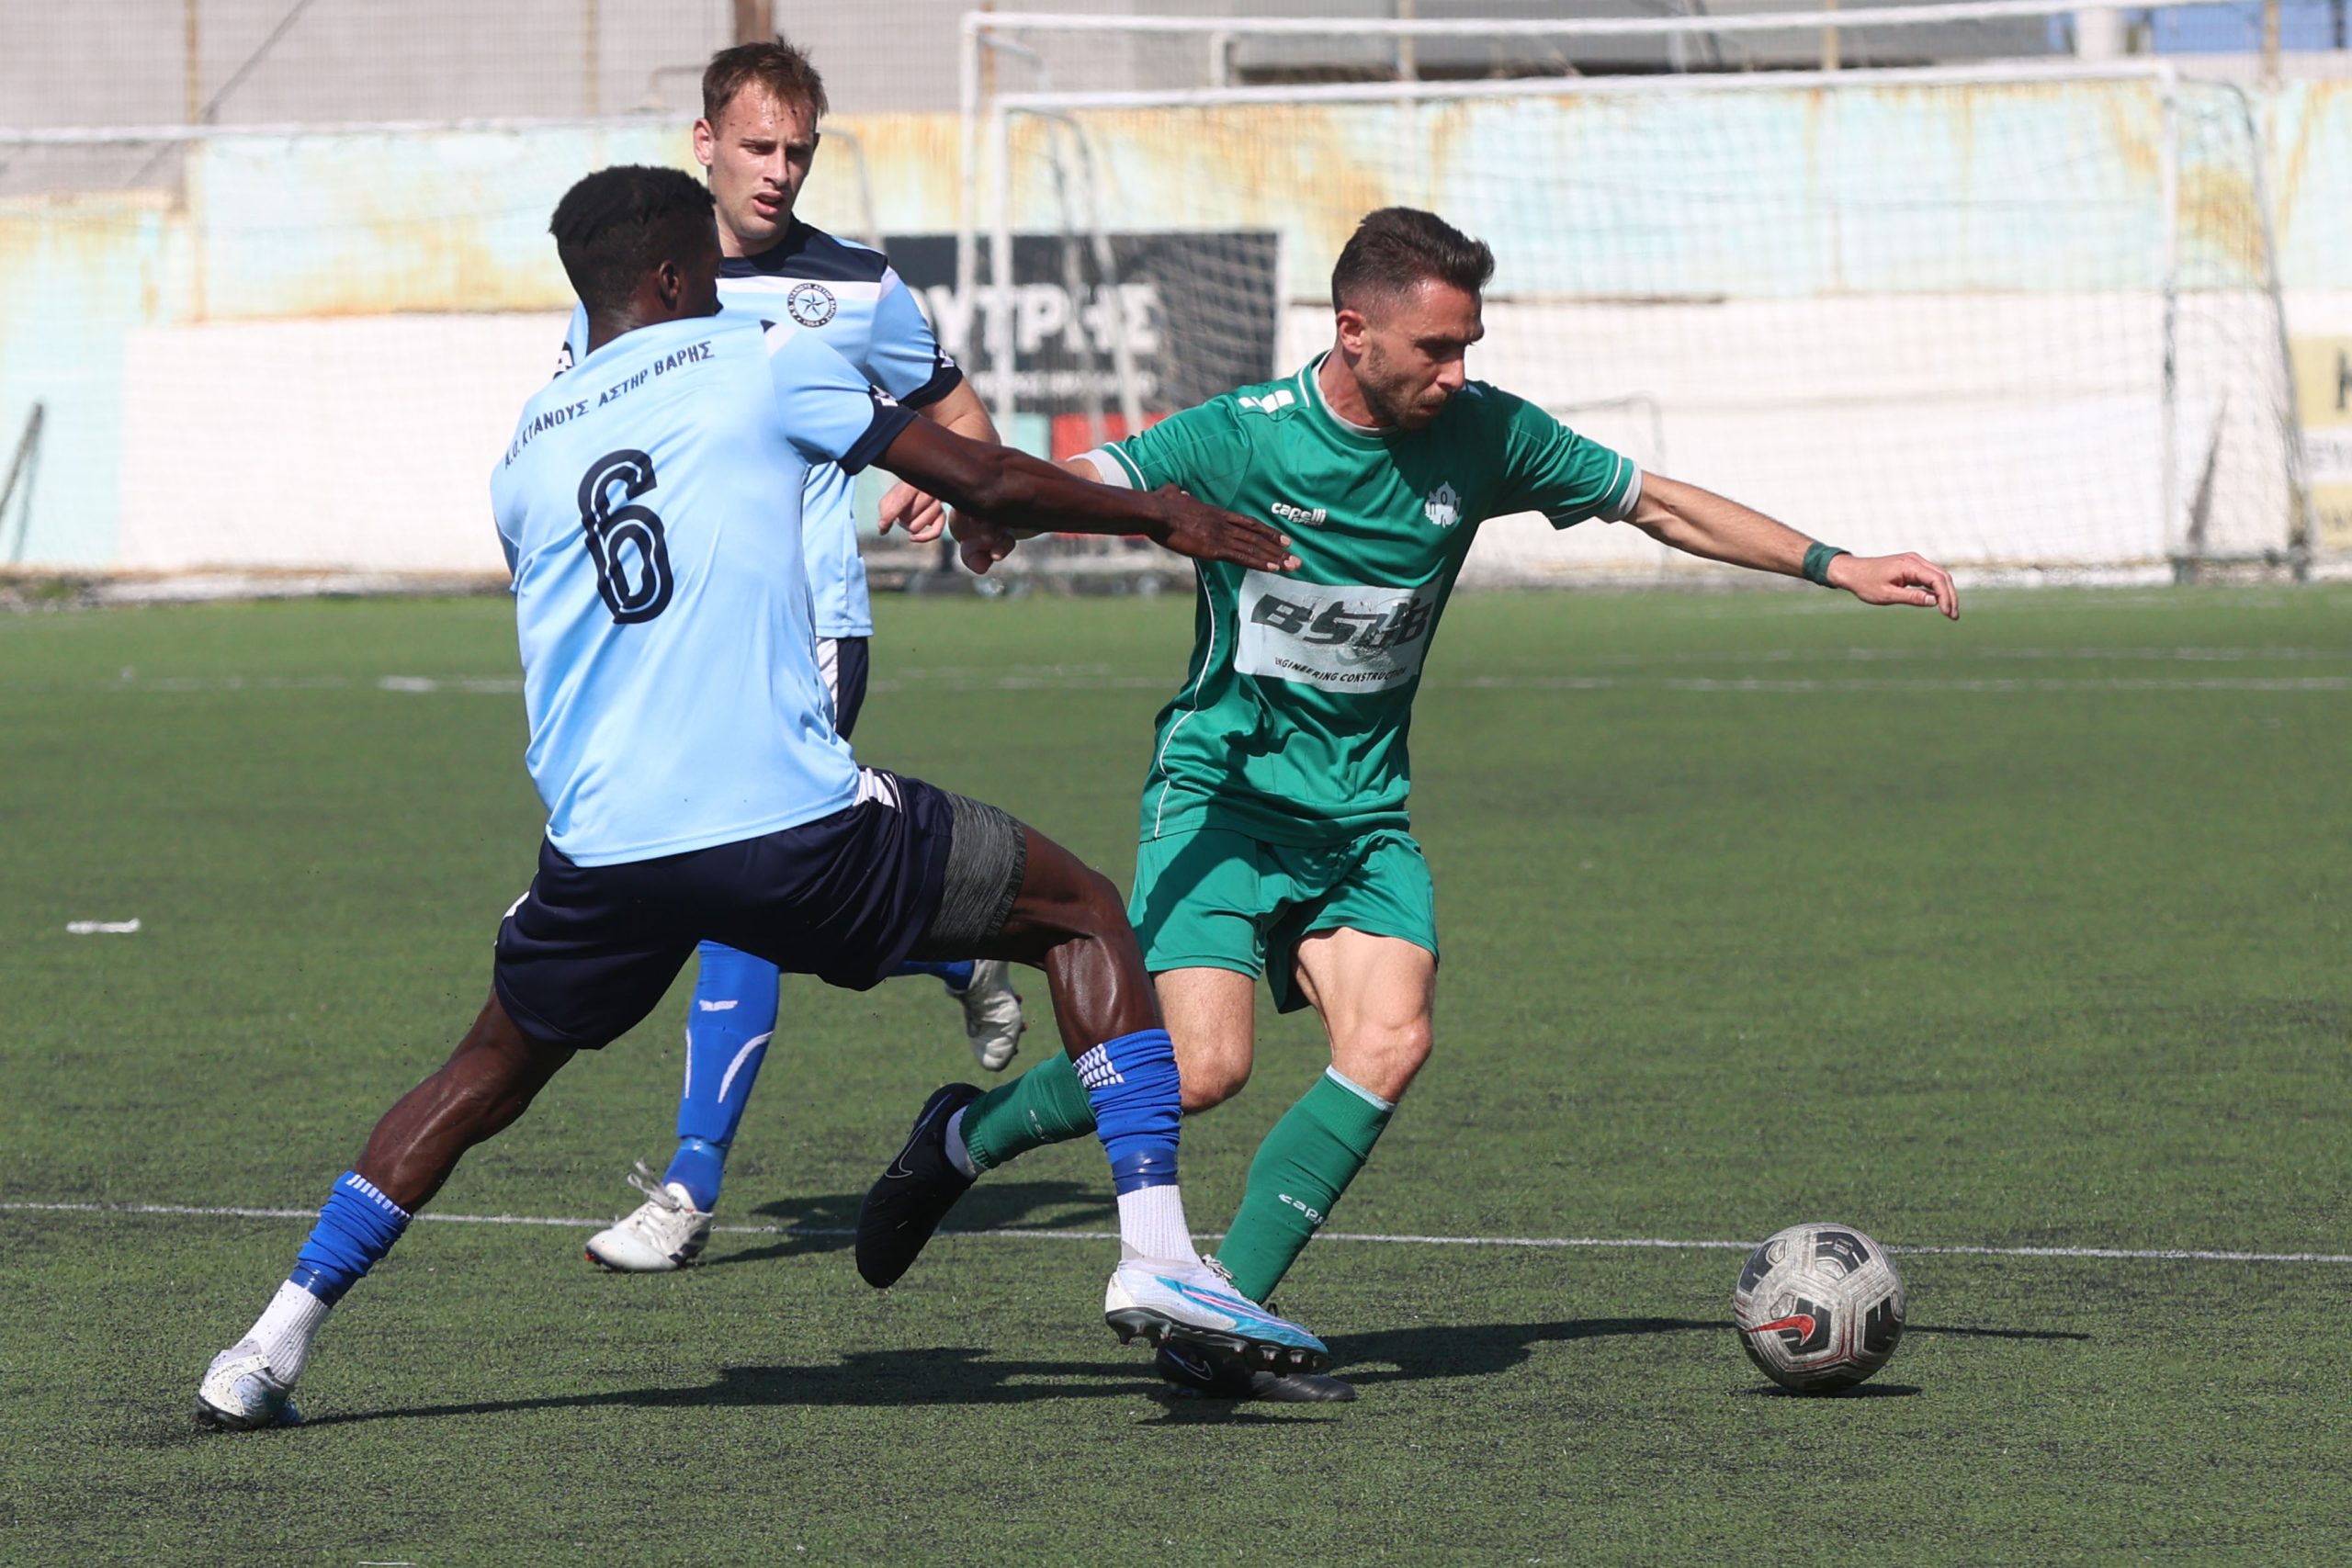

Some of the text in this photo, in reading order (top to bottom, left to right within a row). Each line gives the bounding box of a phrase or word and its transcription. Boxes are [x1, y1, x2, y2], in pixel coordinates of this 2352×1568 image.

[522, 399, 590, 447] ΚΥΑΝΟΥΣ
[598, 368, 649, 408] ΑΣΤΗΡ
[653, 340, 716, 377] ΒΑΡΗΣ
[577, 448, 675, 626] 6
[1271, 502, 1327, 522] capelli
